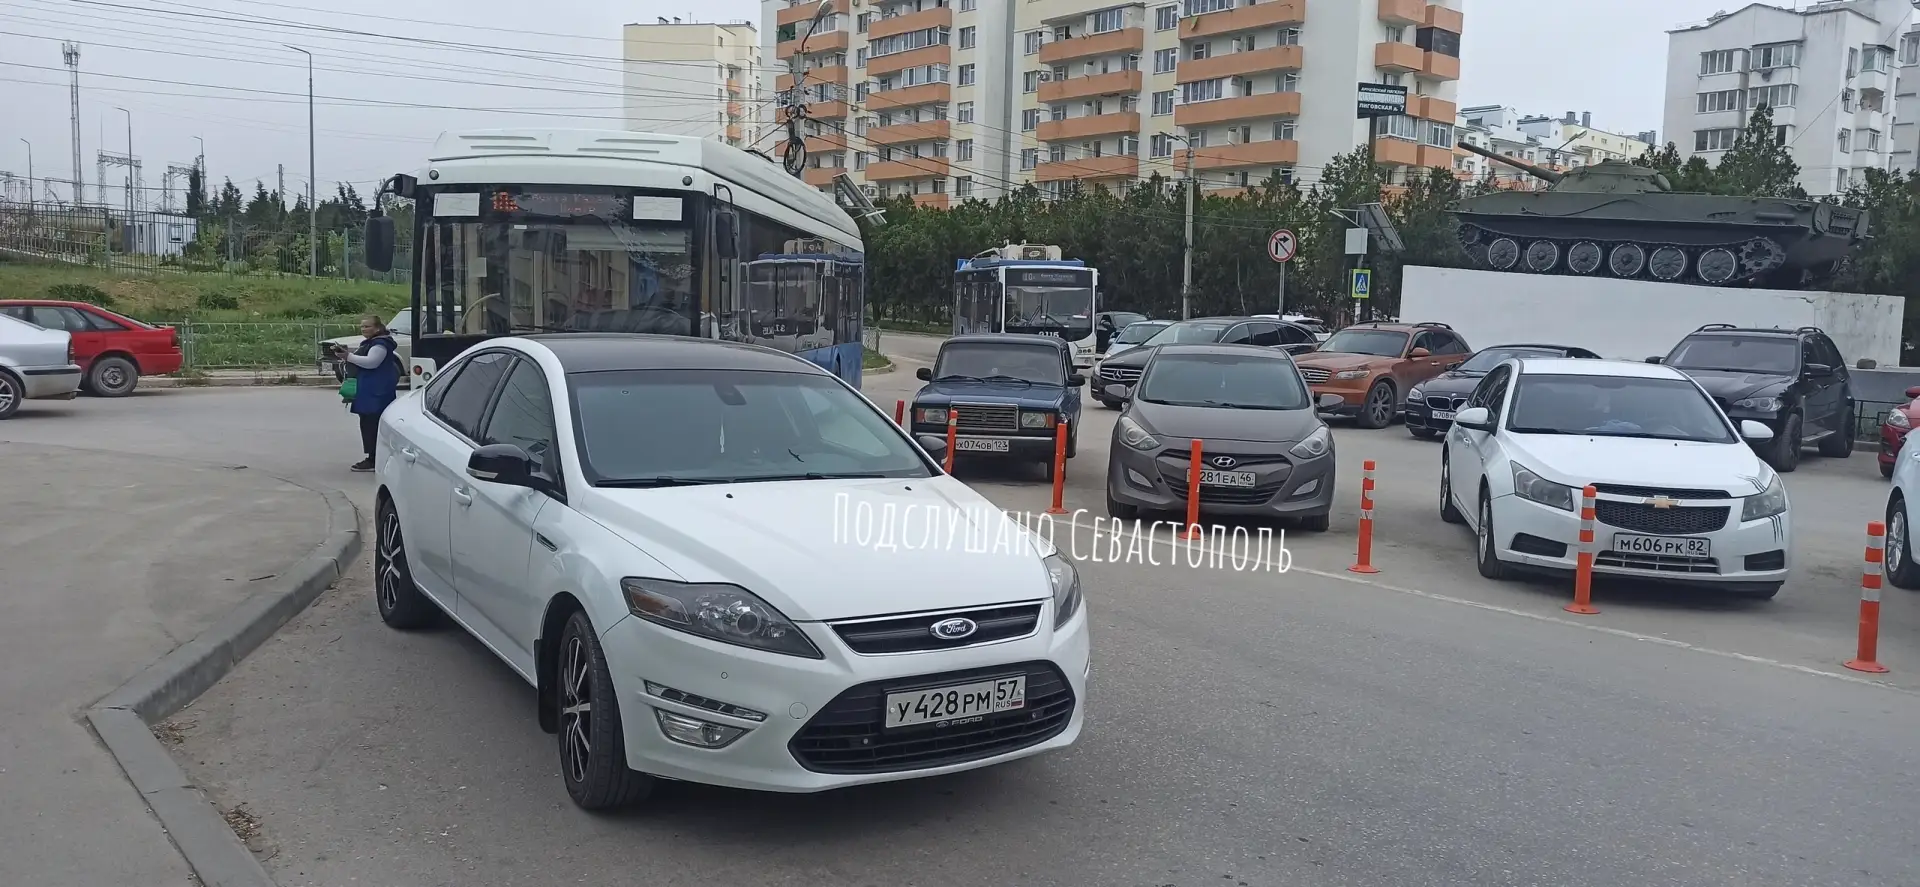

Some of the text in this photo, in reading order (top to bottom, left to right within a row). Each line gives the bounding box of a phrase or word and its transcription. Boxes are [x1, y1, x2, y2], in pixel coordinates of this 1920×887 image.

[1199, 471, 1251, 484] 281ЕА 46
[1620, 537, 1704, 554] М606РК 82
[897, 679, 1018, 722] У428РМ 57
[995, 700, 1011, 708] RUS
[951, 716, 983, 726] FORD
